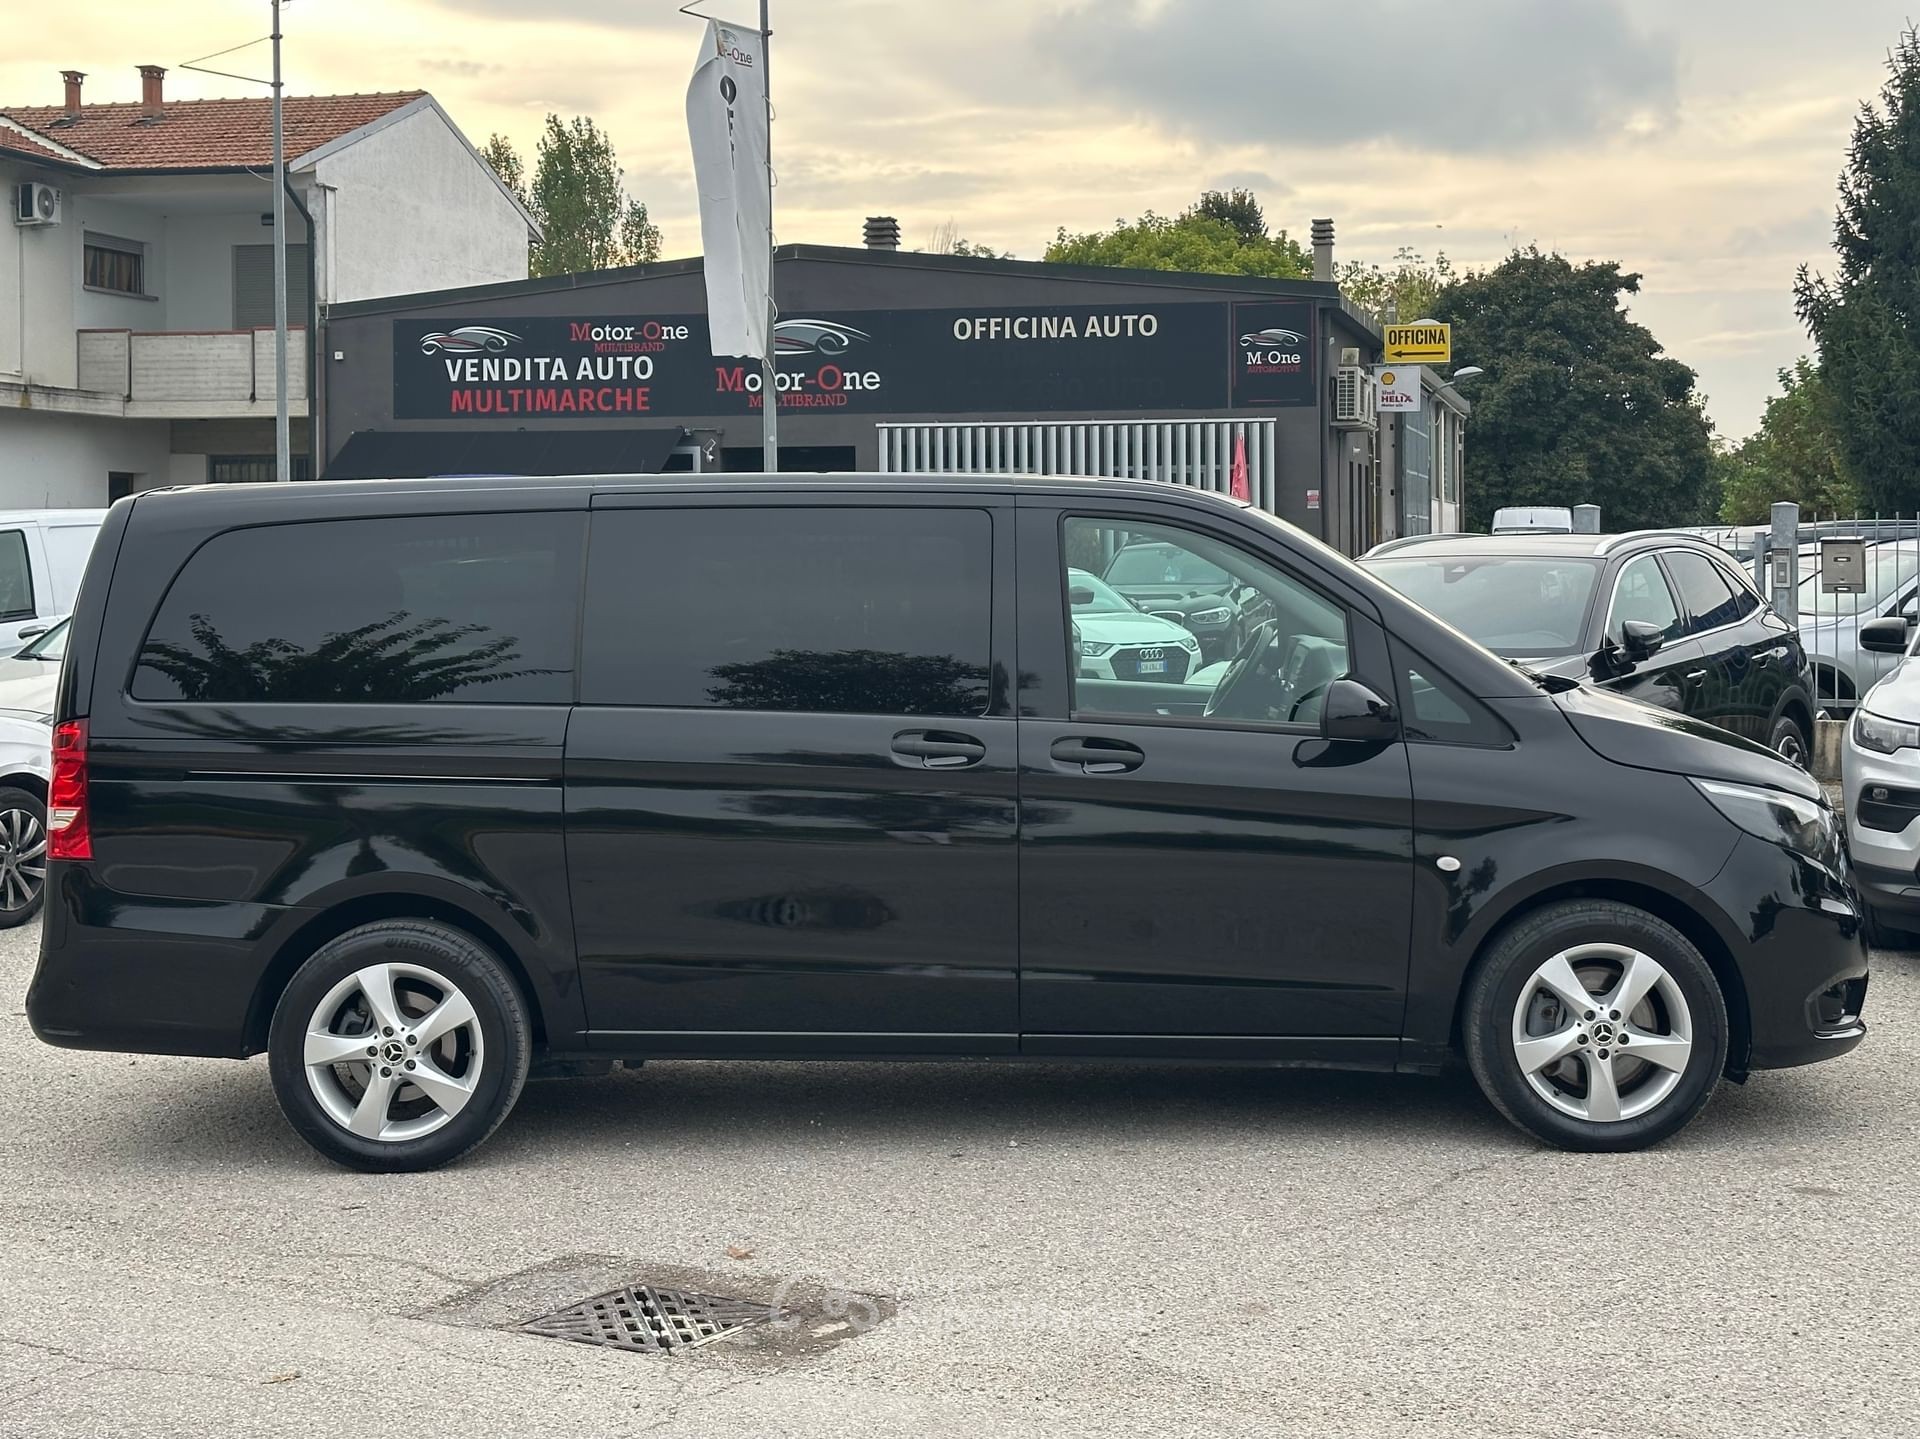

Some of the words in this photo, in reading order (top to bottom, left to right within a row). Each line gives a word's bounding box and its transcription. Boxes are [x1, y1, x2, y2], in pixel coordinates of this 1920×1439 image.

[570, 321, 689, 342] Motor-One
[953, 317, 1078, 340] OFFICINA
[1084, 314, 1158, 338] AUTO
[1388, 329, 1446, 345] OFFICINA
[594, 342, 665, 353] MULTIBRAND
[1246, 351, 1301, 365] M-One
[445, 358, 568, 382] VENDITA
[575, 356, 654, 381] AUTO
[715, 365, 881, 393] Moor-One
[451, 387, 650, 413] MULTIMARCHE
[1381, 393, 1413, 402] HELIX
